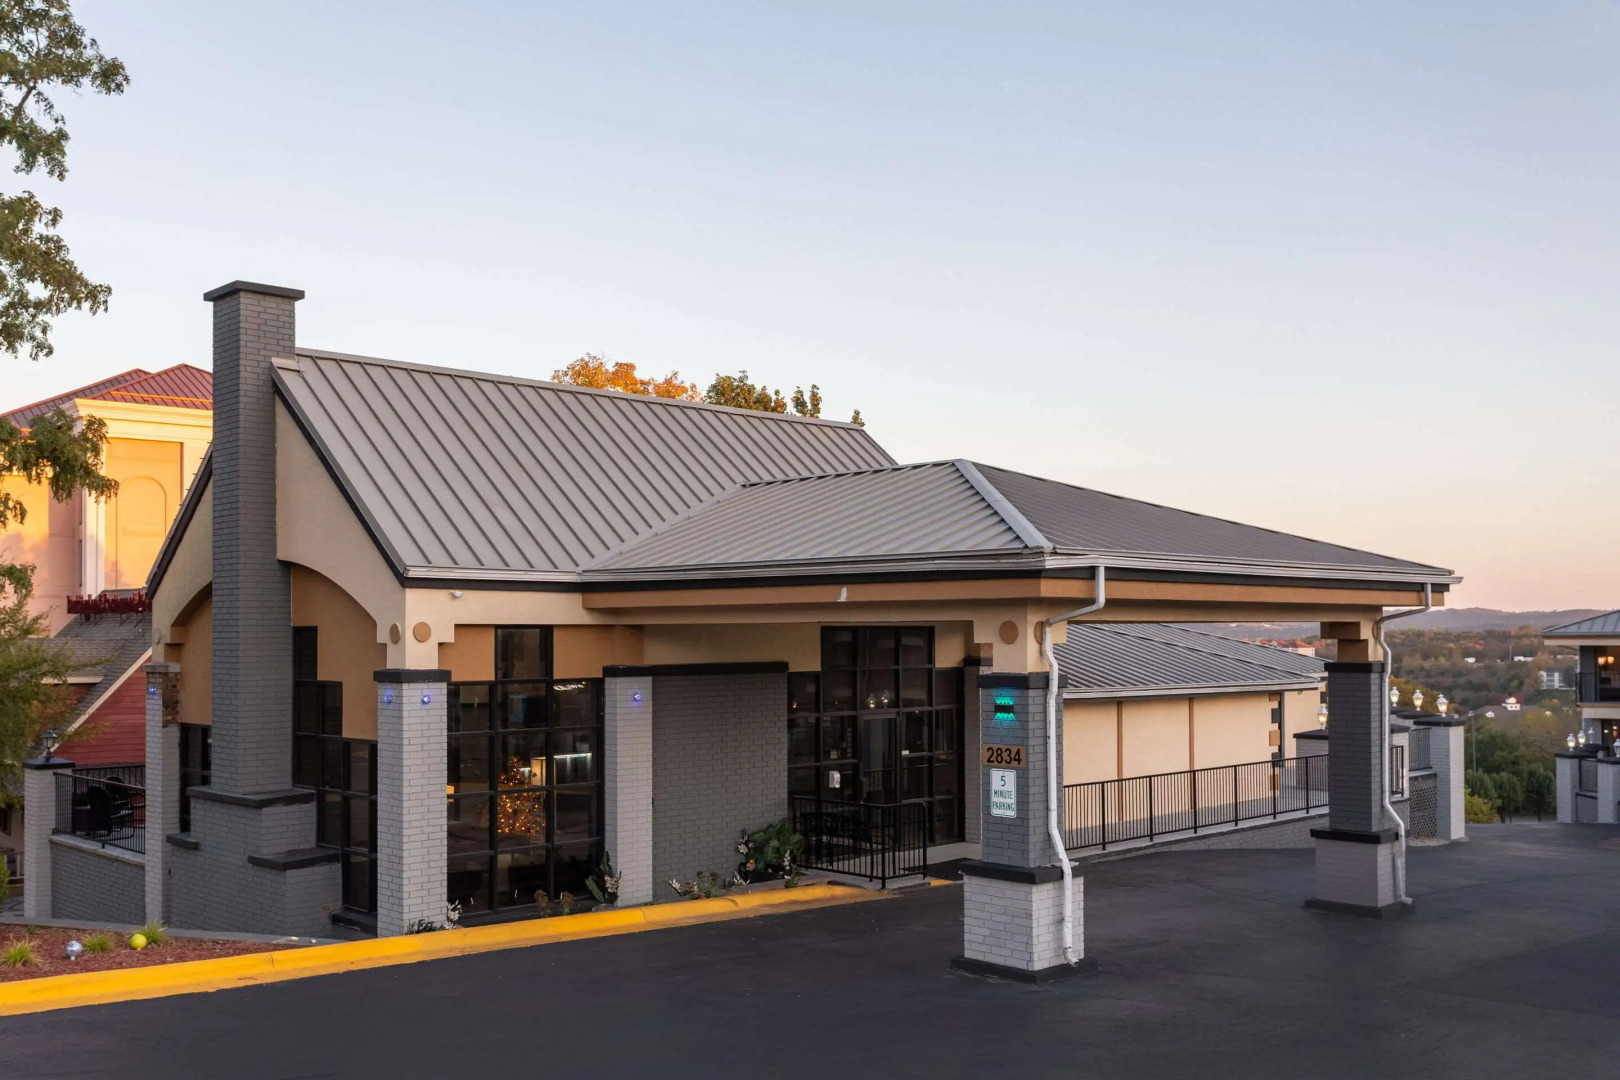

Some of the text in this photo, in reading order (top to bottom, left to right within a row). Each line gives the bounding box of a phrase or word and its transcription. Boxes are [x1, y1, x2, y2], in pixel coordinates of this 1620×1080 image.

[986, 747, 1022, 765] 2834
[1000, 775, 1006, 787] 5
[993, 789, 1013, 799] MINUTE
[992, 801, 1015, 811] PARKING
